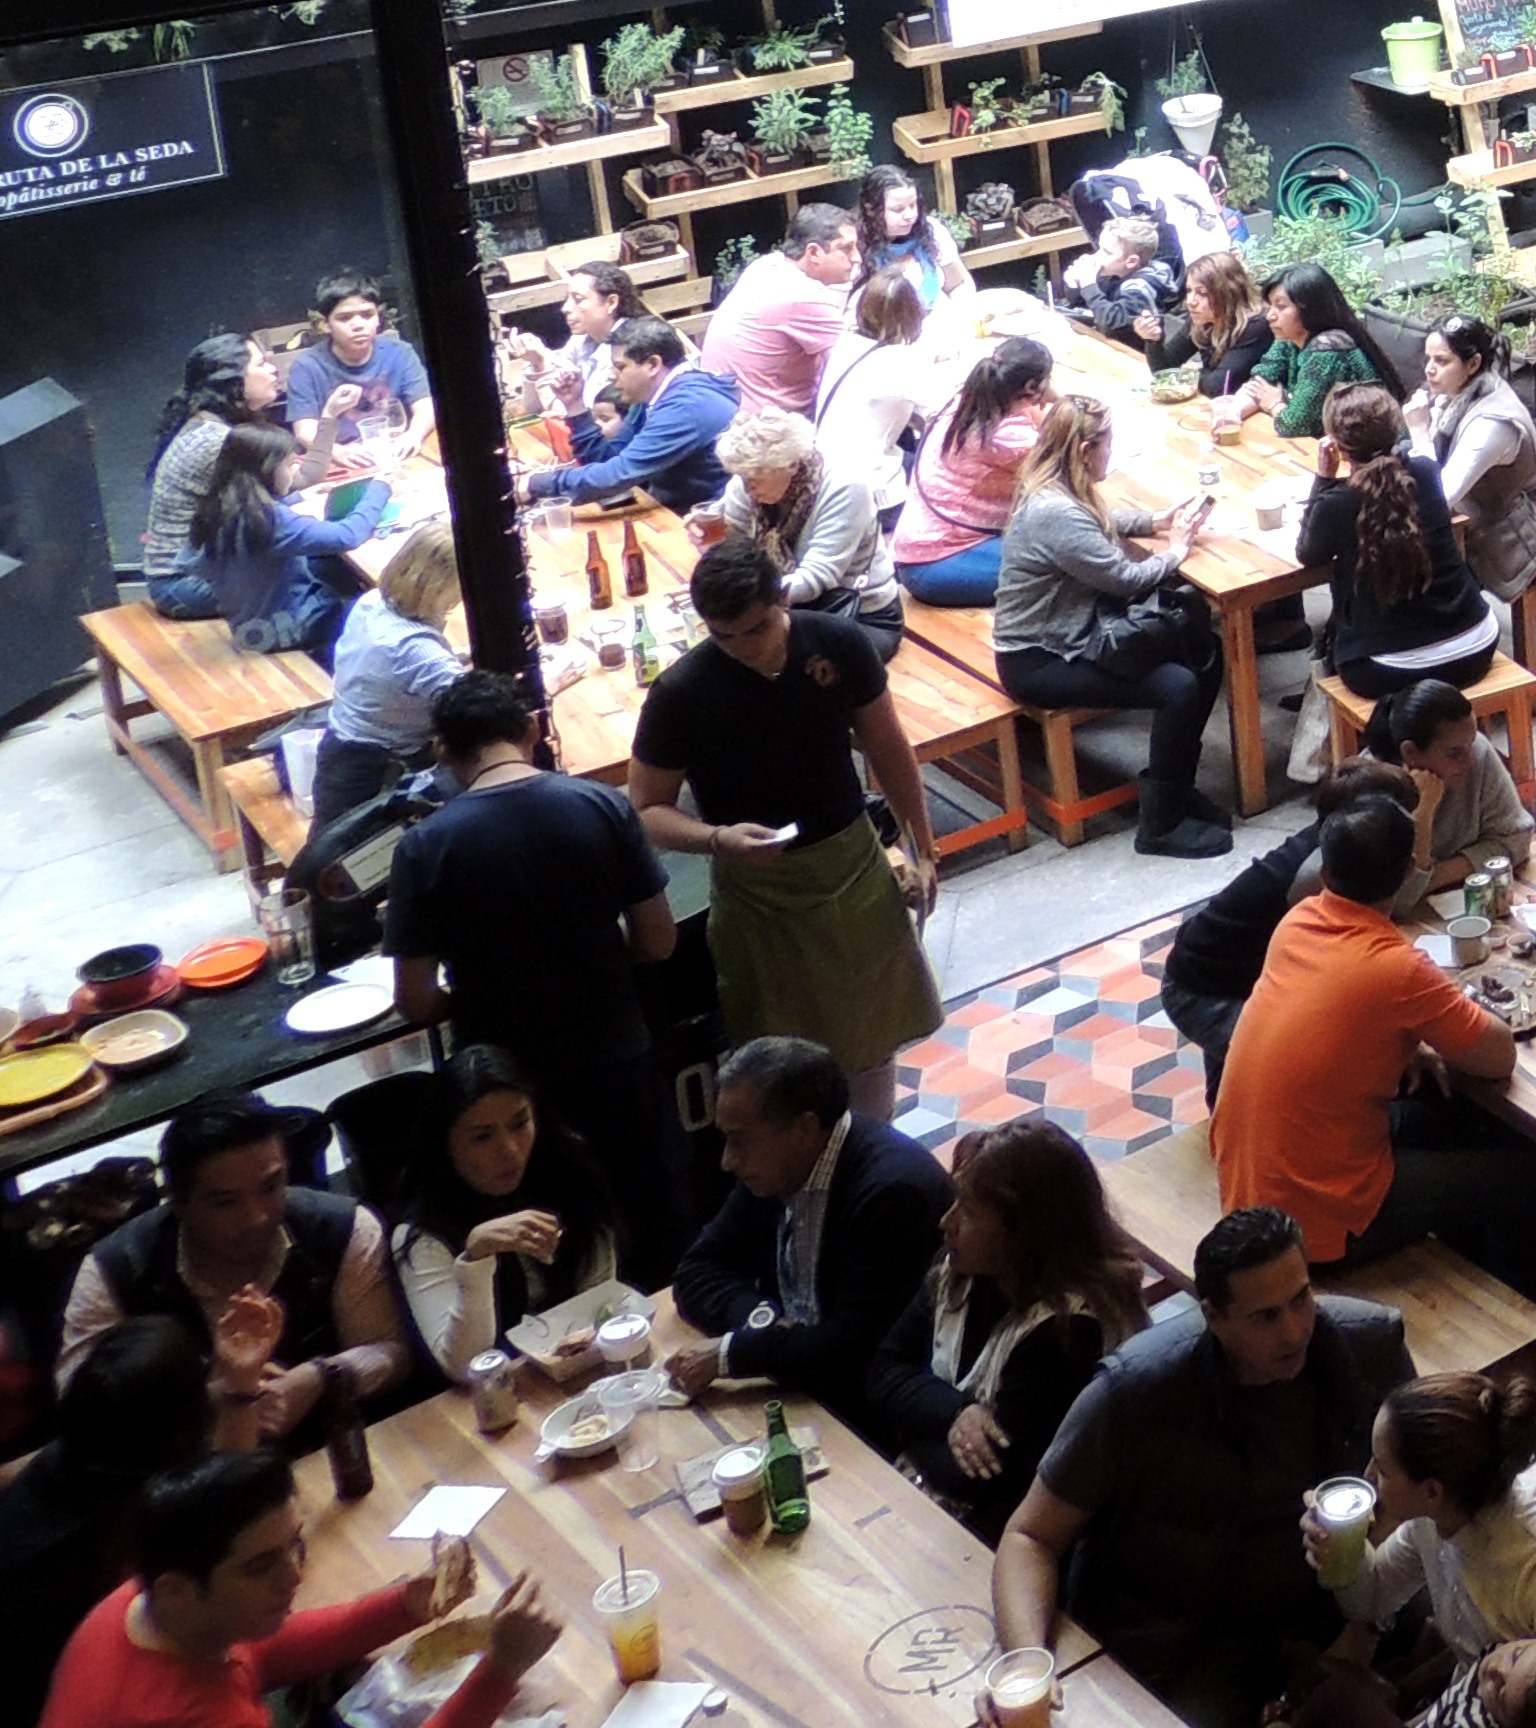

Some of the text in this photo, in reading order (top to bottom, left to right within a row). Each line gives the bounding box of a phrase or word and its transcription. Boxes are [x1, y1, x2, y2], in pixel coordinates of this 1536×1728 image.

[59, 157, 93, 177] DE
[99, 151, 131, 169] LA
[135, 140, 194, 163] SEDA
